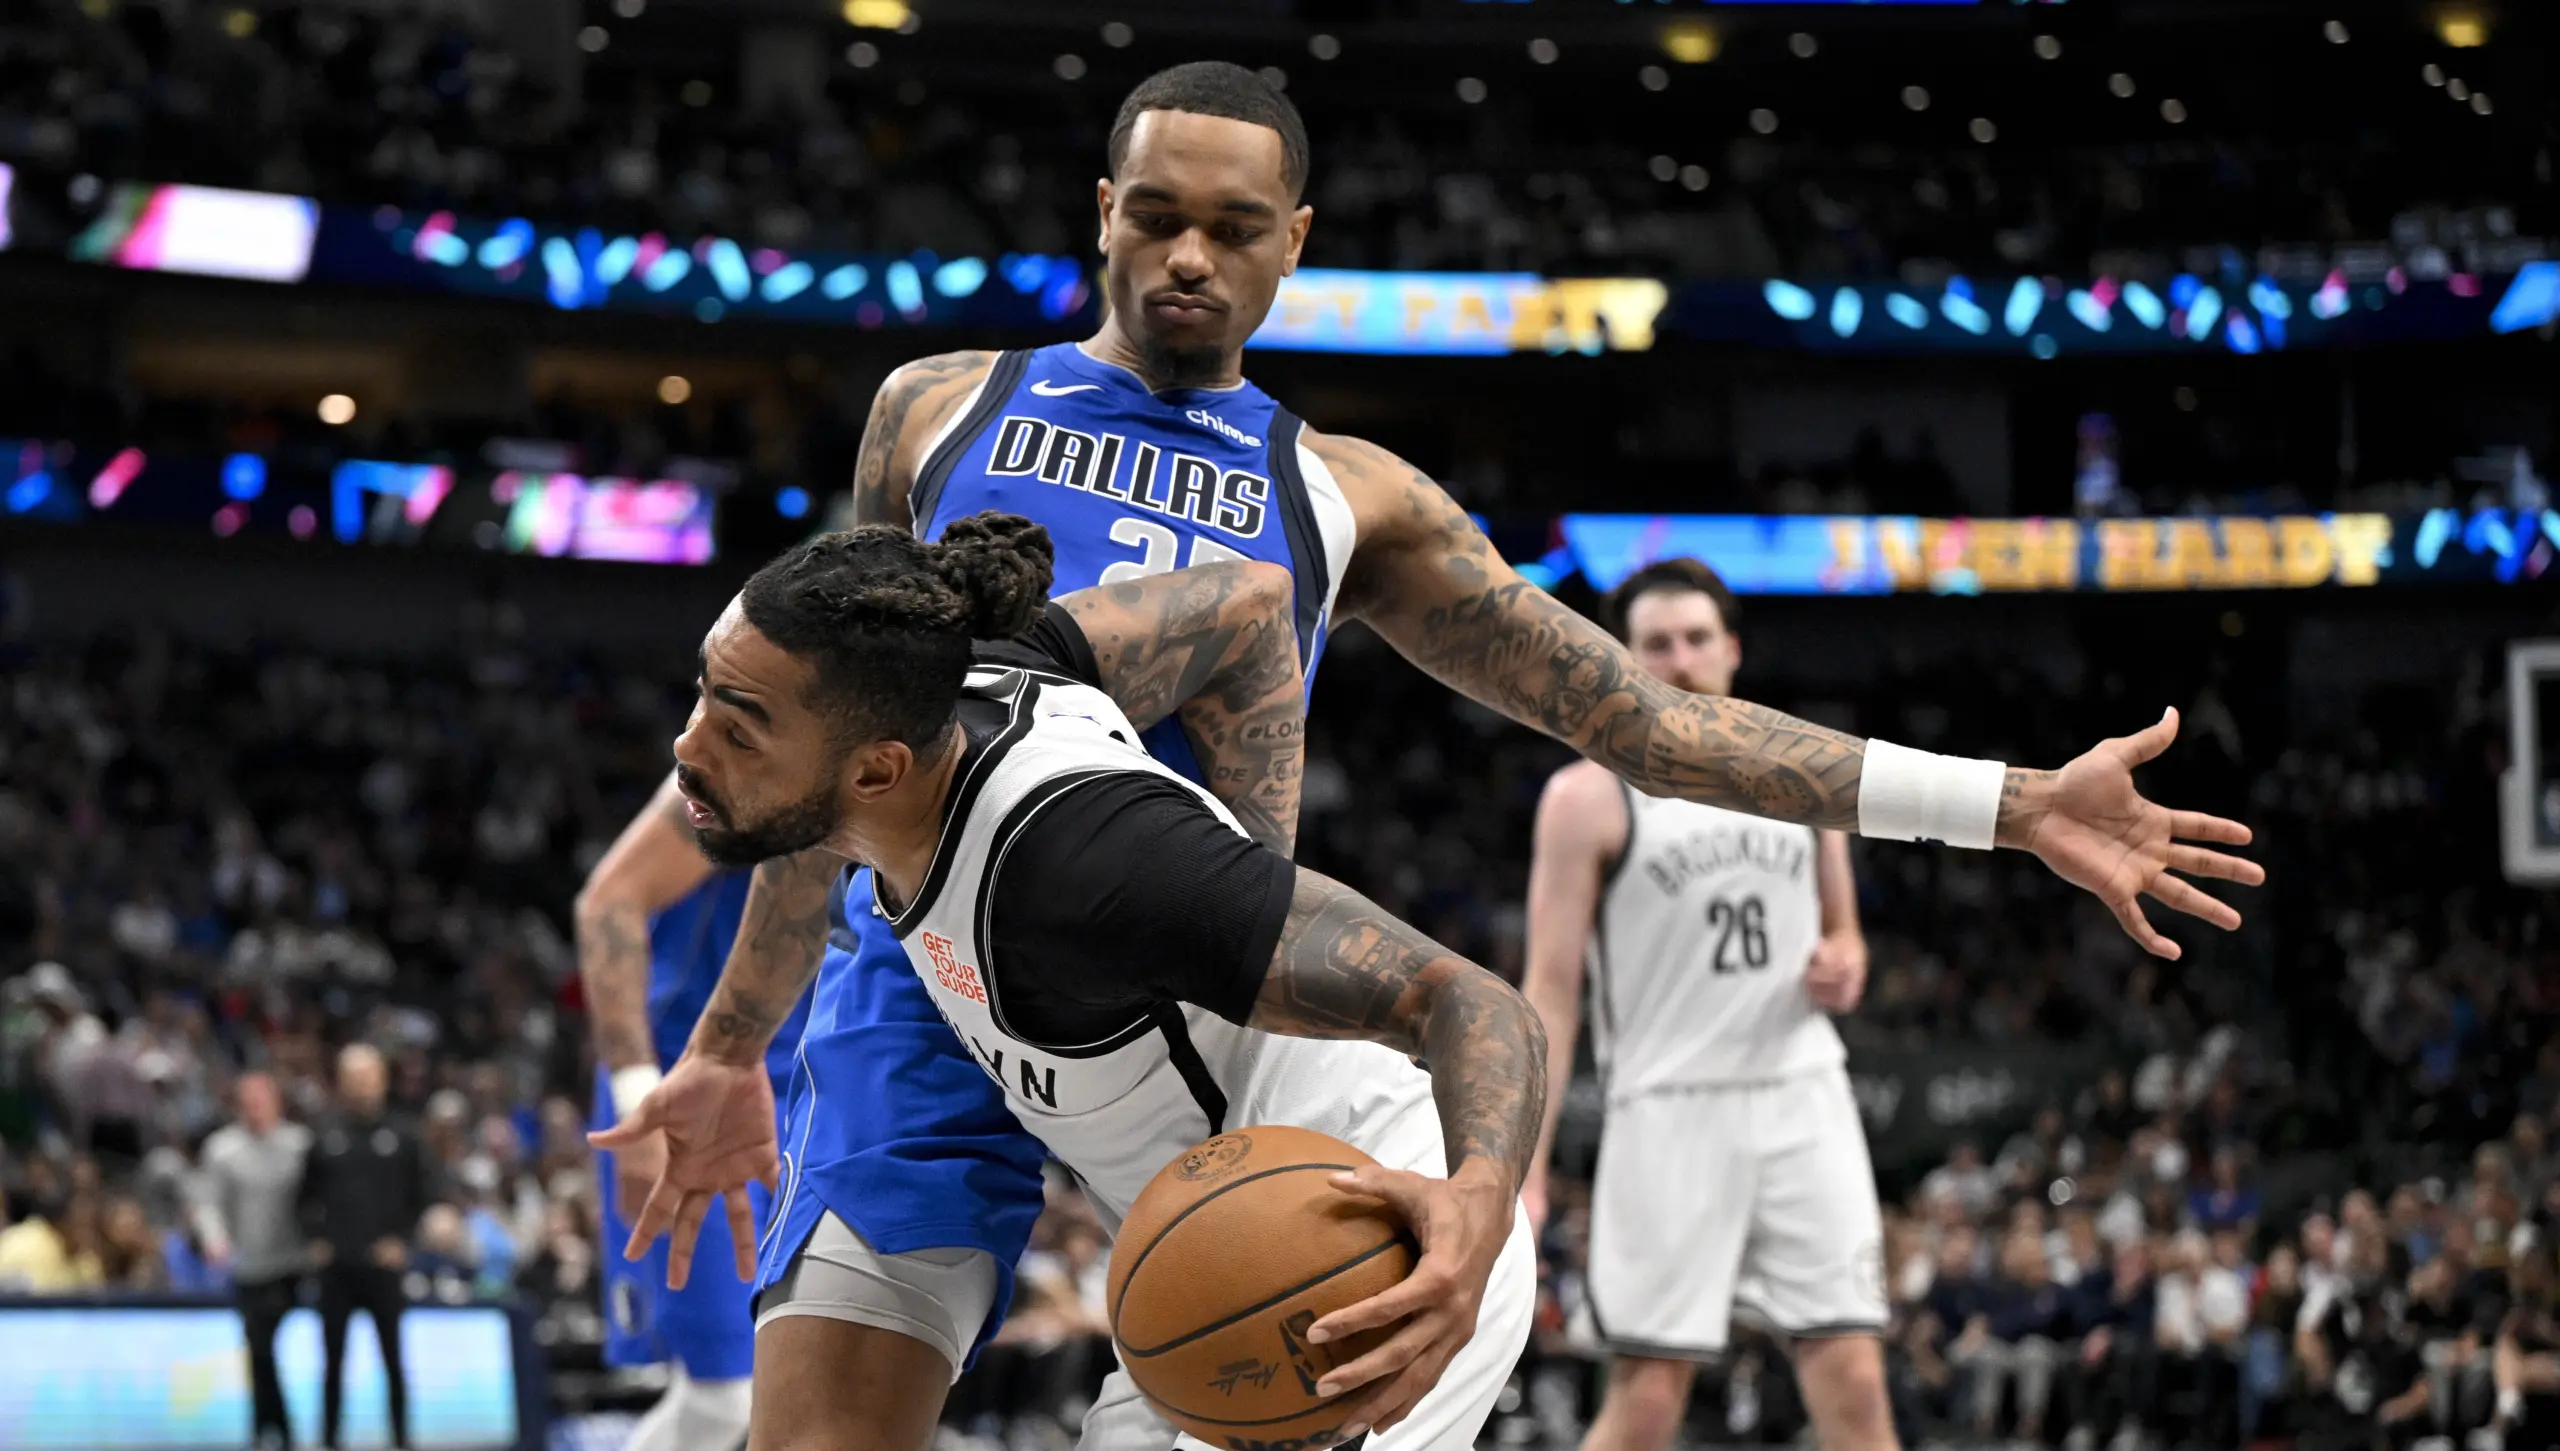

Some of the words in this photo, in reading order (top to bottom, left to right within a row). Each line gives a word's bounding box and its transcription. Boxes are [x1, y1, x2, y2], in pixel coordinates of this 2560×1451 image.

[1185, 409, 1262, 447] chime
[985, 415, 1270, 538] DALLAS
[2099, 513, 2391, 589] HARDY
[922, 931, 953, 958] GET
[1706, 896, 1770, 973] 26
[927, 951, 979, 985] YOUR
[935, 969, 987, 1005] GUIDE
